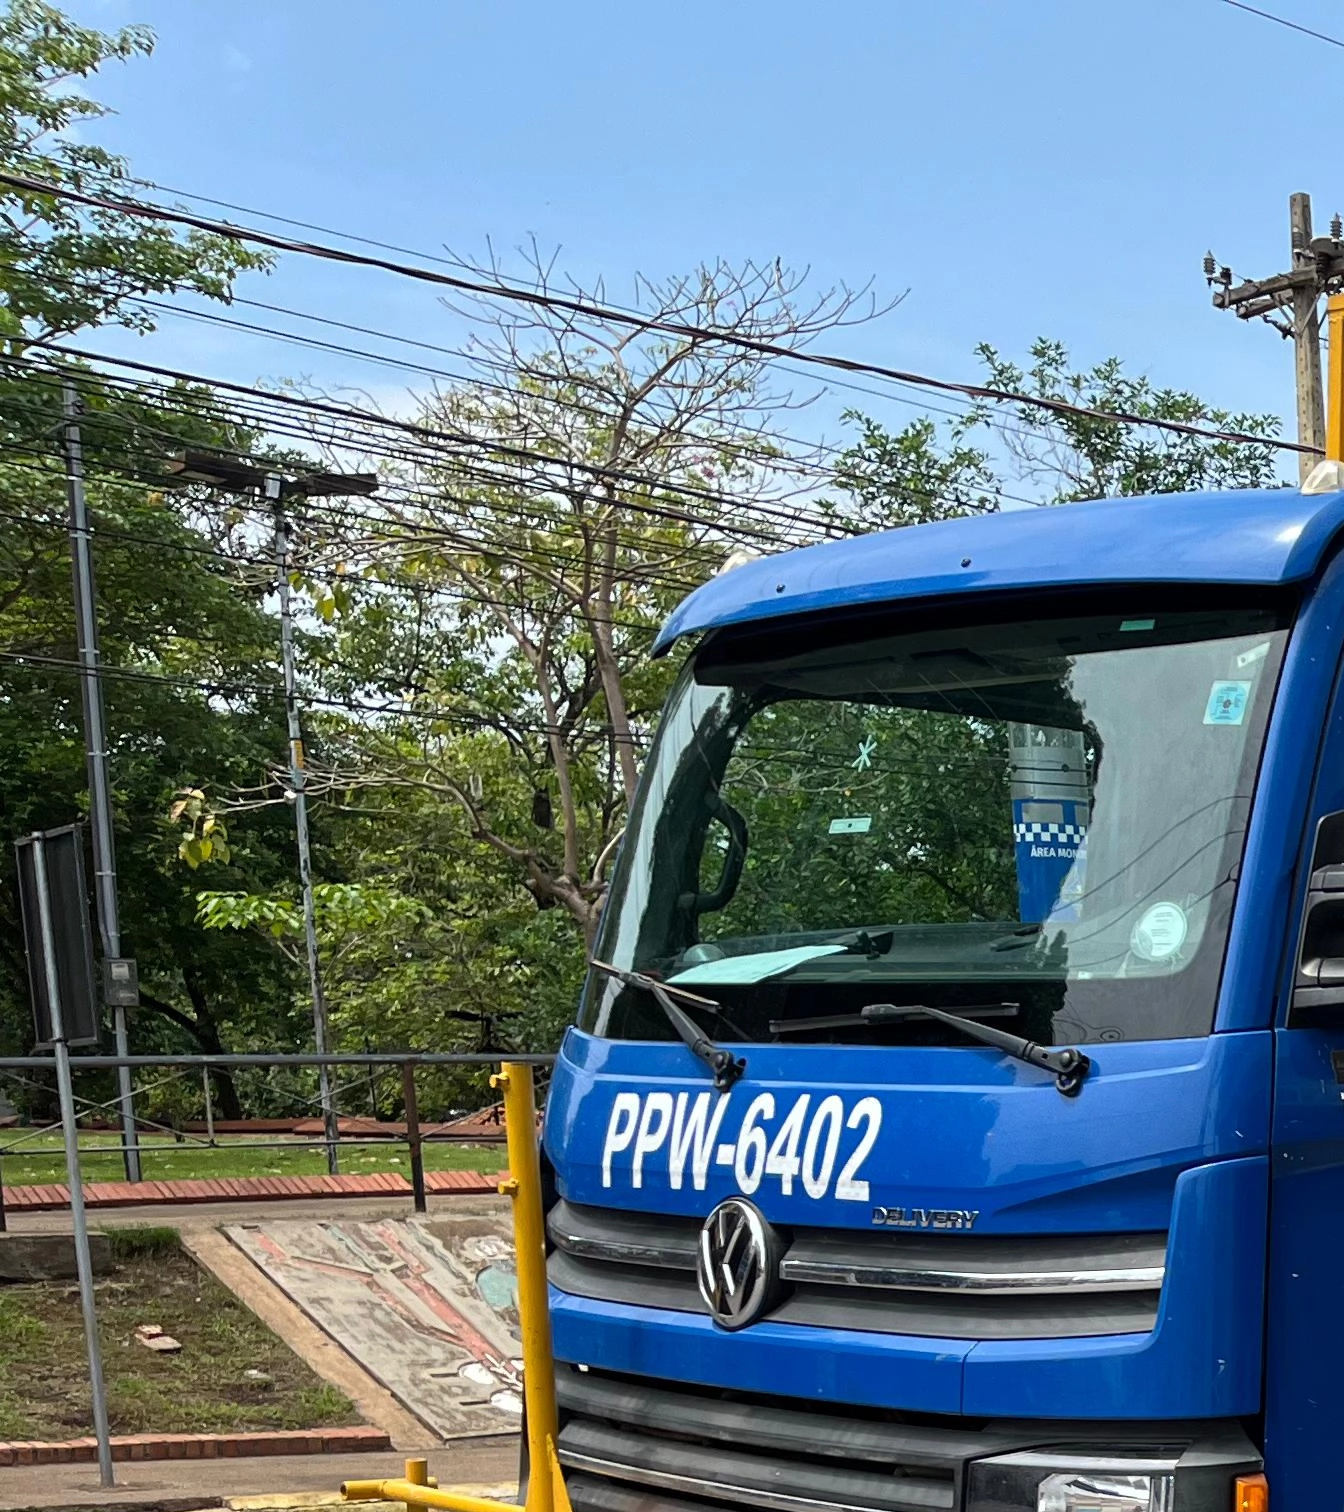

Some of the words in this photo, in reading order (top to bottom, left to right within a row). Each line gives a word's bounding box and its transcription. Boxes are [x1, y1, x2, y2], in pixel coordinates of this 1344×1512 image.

[1030, 844, 1057, 858] ÁREA
[601, 1091, 882, 1201] PPW-6402
[871, 1206, 980, 1229] DELIVERY
